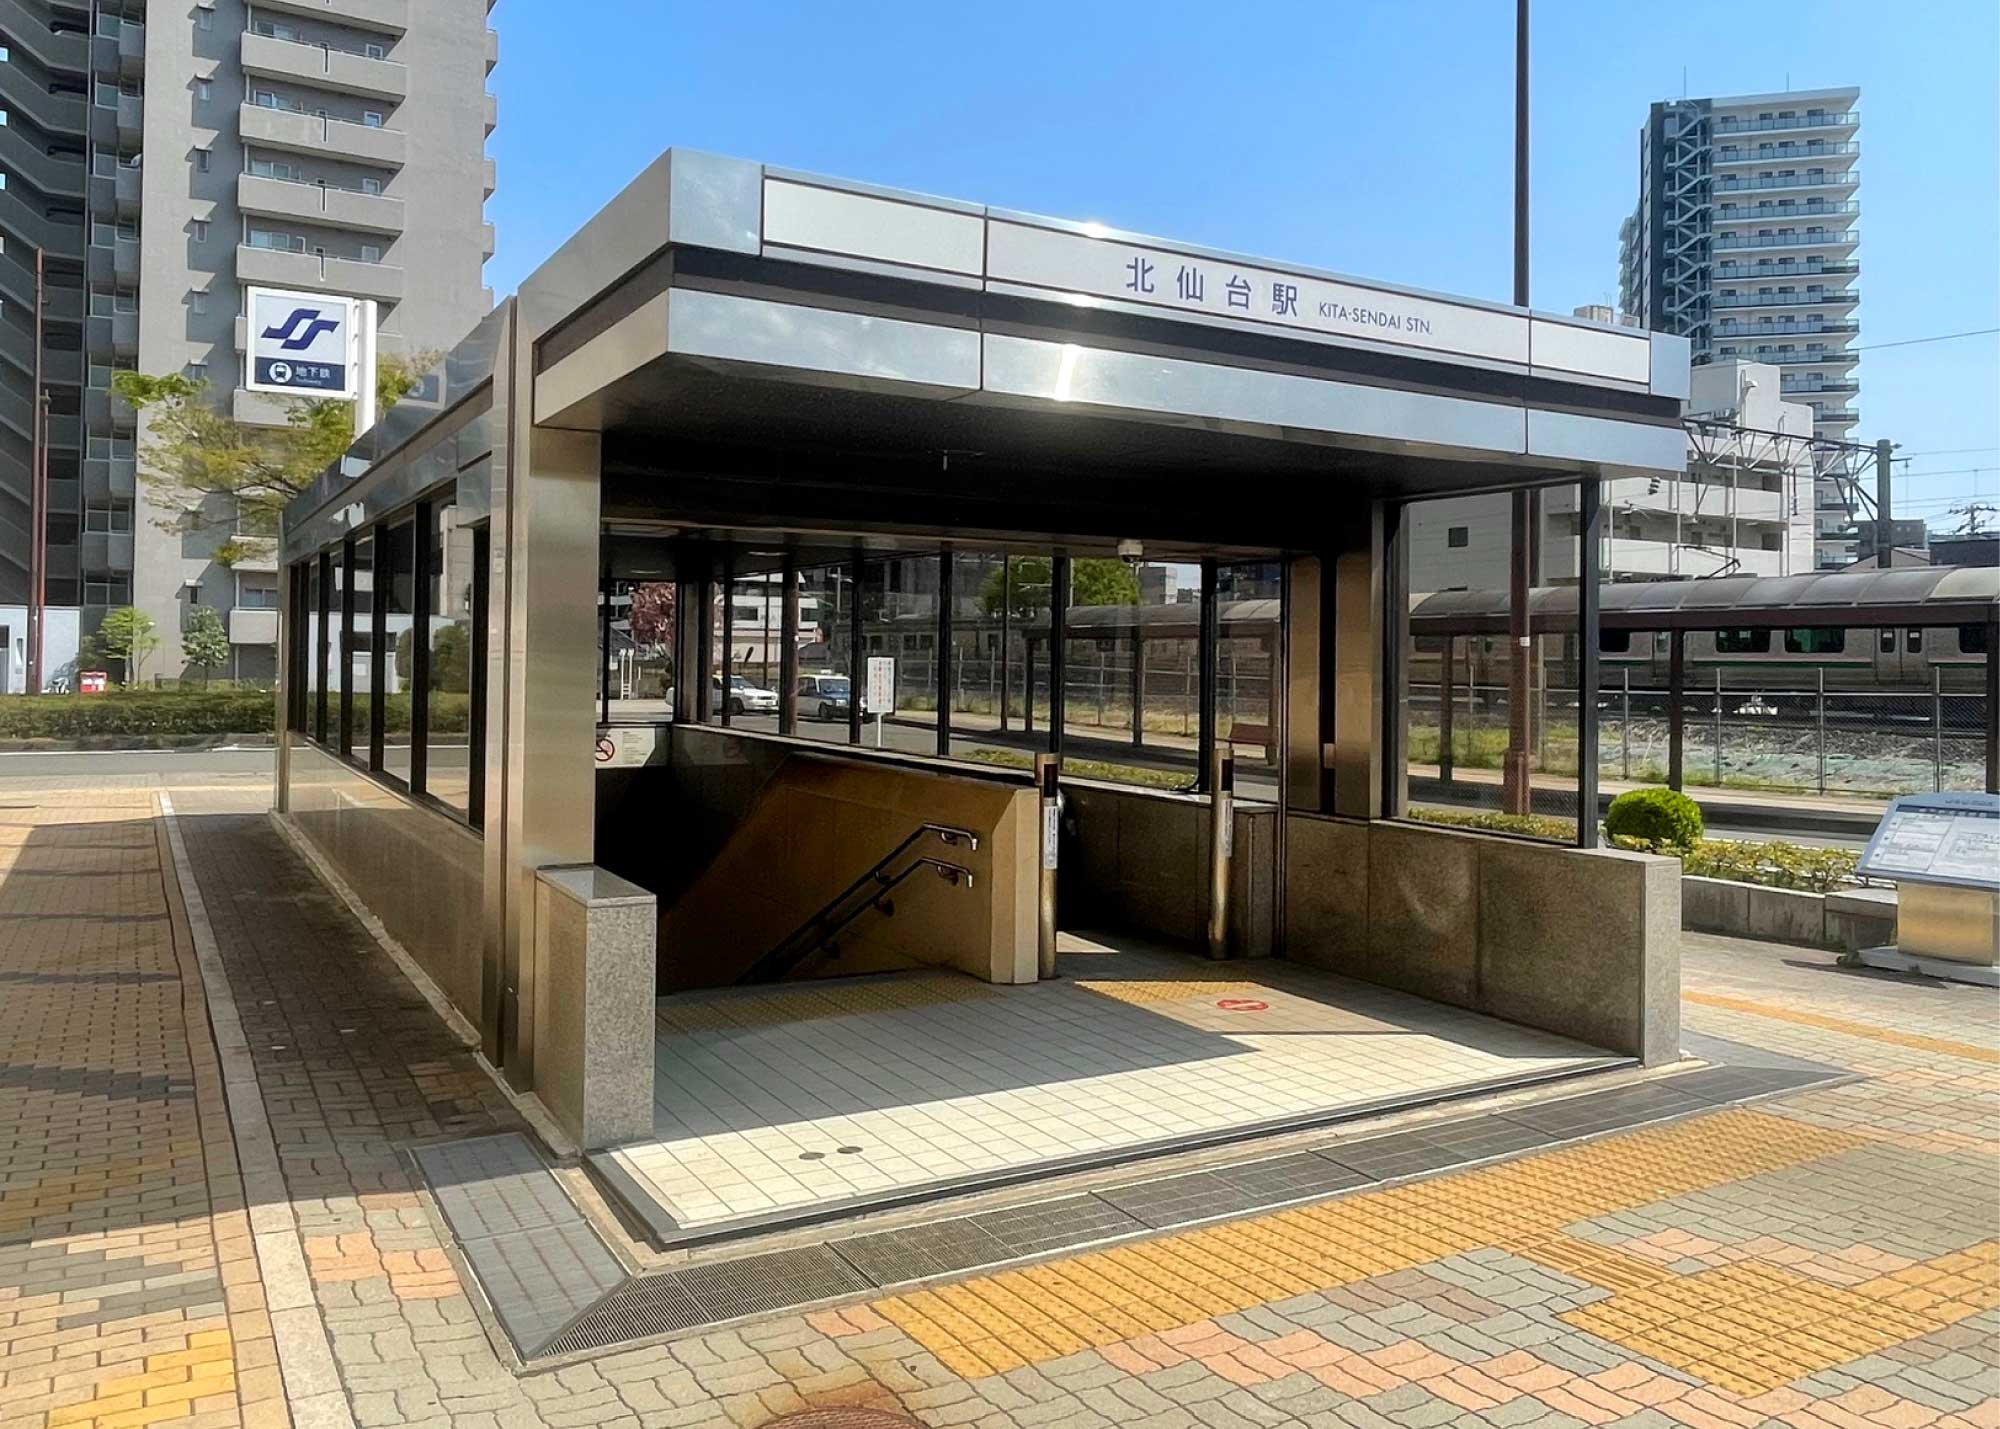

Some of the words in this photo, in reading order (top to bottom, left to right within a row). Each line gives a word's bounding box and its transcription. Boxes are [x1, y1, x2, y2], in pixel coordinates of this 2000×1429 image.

[1125, 256, 1298, 317] 北仙台駅
[1318, 301, 1401, 329] KITA-SENDAI
[1405, 315, 1433, 335] STN.
